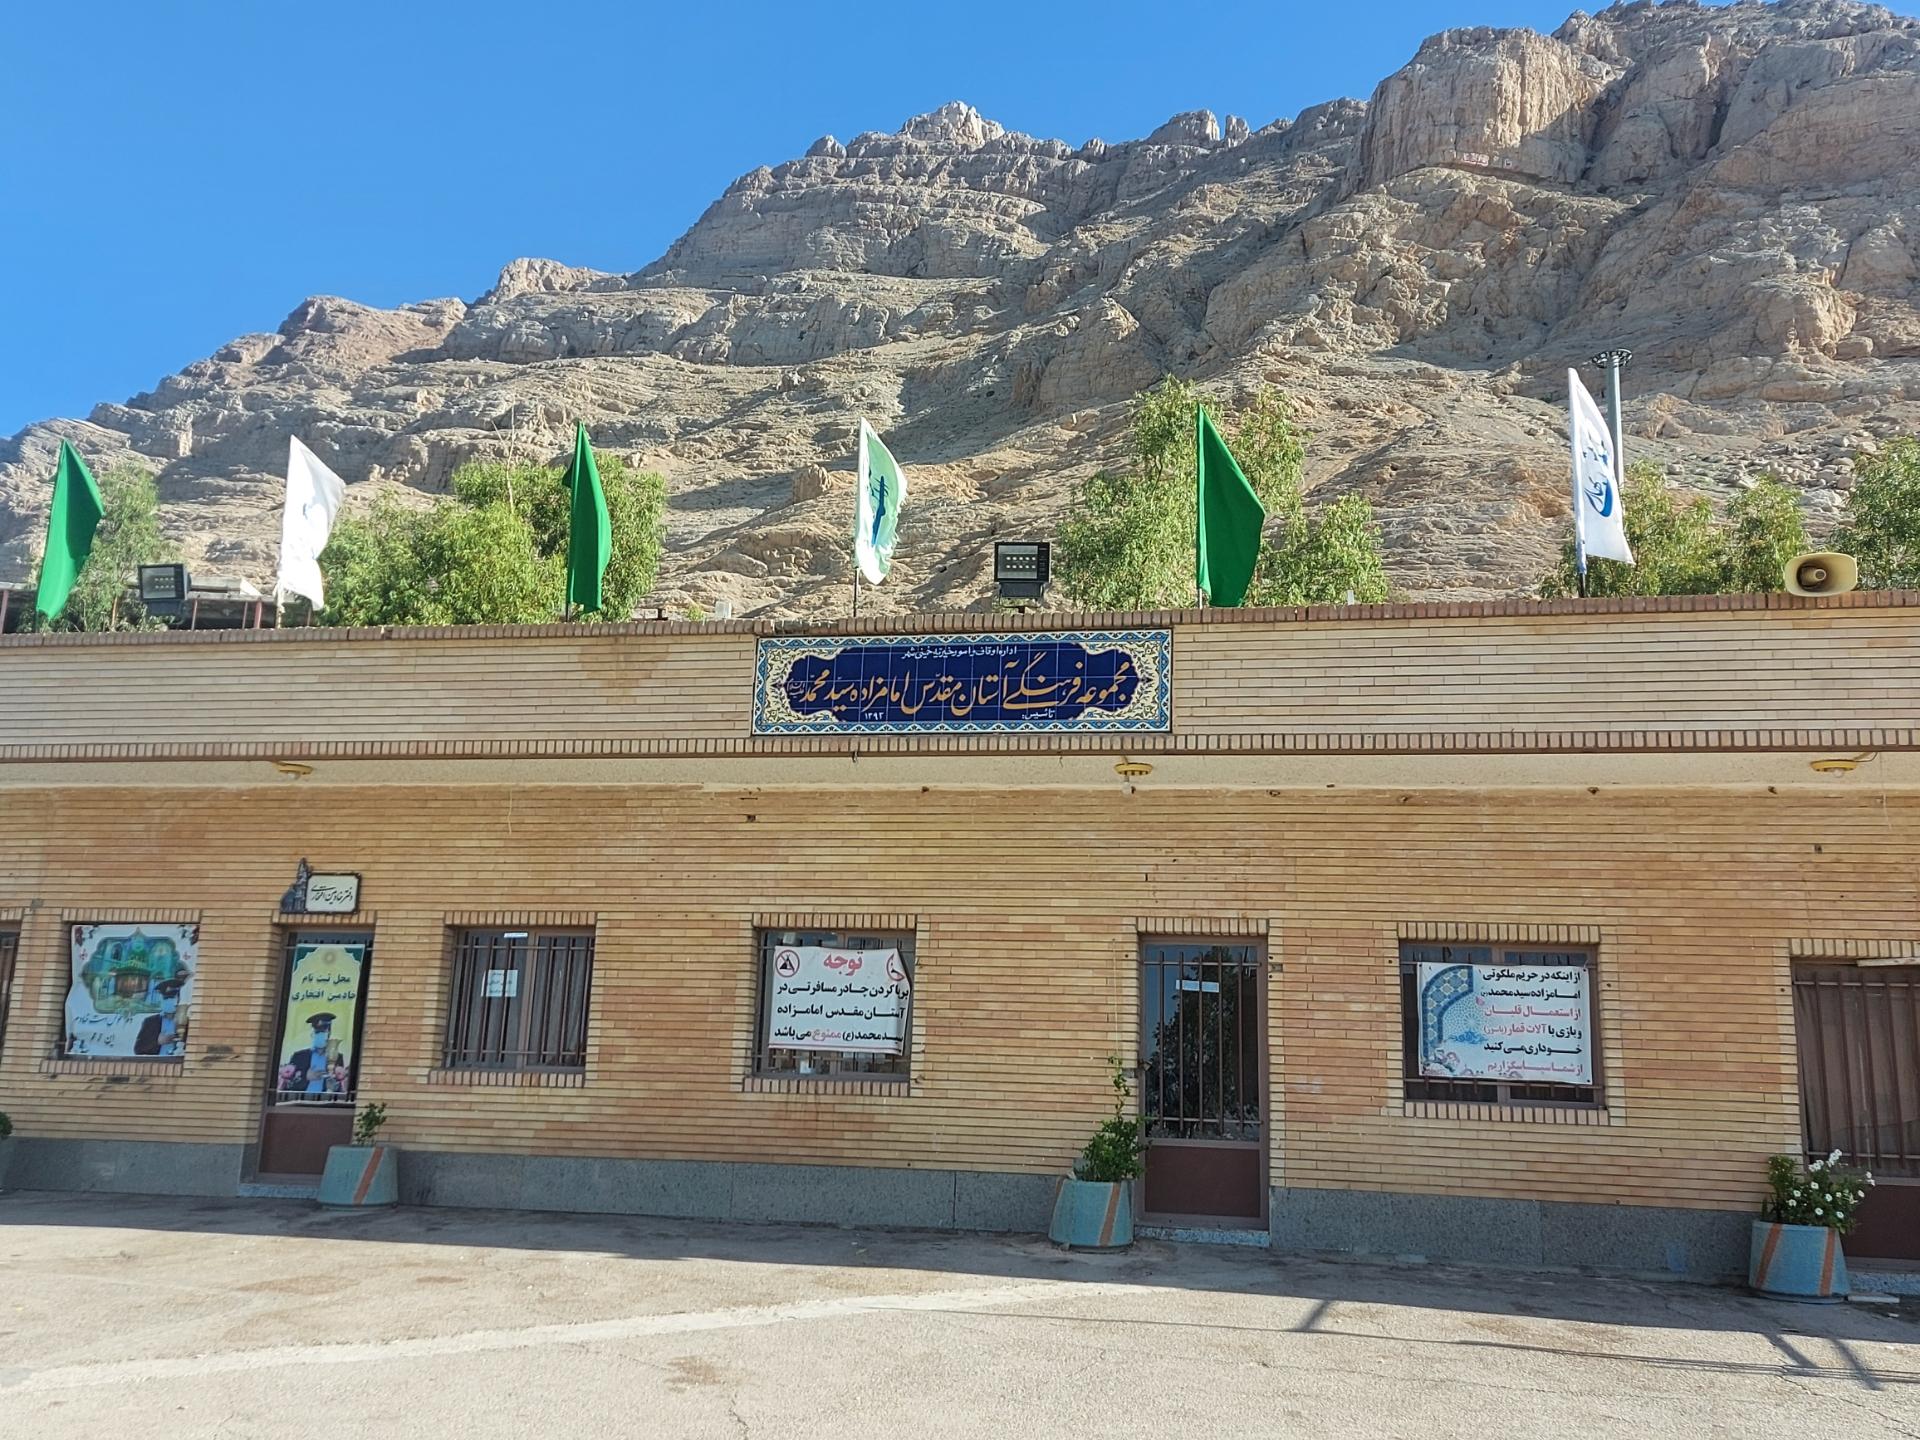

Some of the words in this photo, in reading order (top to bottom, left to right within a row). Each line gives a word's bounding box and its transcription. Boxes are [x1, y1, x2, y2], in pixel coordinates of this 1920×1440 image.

[951, 645, 971, 658] امور
[976, 645, 999, 656] اوقاف
[998, 645, 1017, 657] اداره
[951, 659, 1020, 716] آستان
[1003, 652, 1084, 710] فرهنگی
[1075, 661, 1130, 706] مجموعه
[823, 951, 863, 976] توجه
[333, 973, 351, 985] محل
[1482, 968, 1515, 981] ملکوتی
[1516, 971, 1539, 982] حریم
[1539, 972, 1550, 982] در
[1551, 971, 1573, 983] اینکه
[1573, 970, 1581, 984] از
[776, 982, 788, 994] در
[788, 981, 837, 995] مسافرتی
[838, 983, 869, 997] چادر
[869, 984, 895, 998] کردن
[1531, 988, 1581, 1001] امامزاده
[777, 1003, 823, 1017] امامزاده
[825, 1006, 864, 1018] مقدس
[864, 1006, 906, 1020] آستان
[1484, 1004, 1522, 1017] قلیان
[1522, 1005, 1573, 1017] استعمال
[1573, 1008, 1581, 1020] از
[812, 1028, 841, 1041] ممنوع
[1508, 1022, 1526, 1036] قمار
[1526, 1023, 1548, 1033] آلات
[1547, 1024, 1555, 1037] با
[1551, 1061, 1575, 1073] شما
